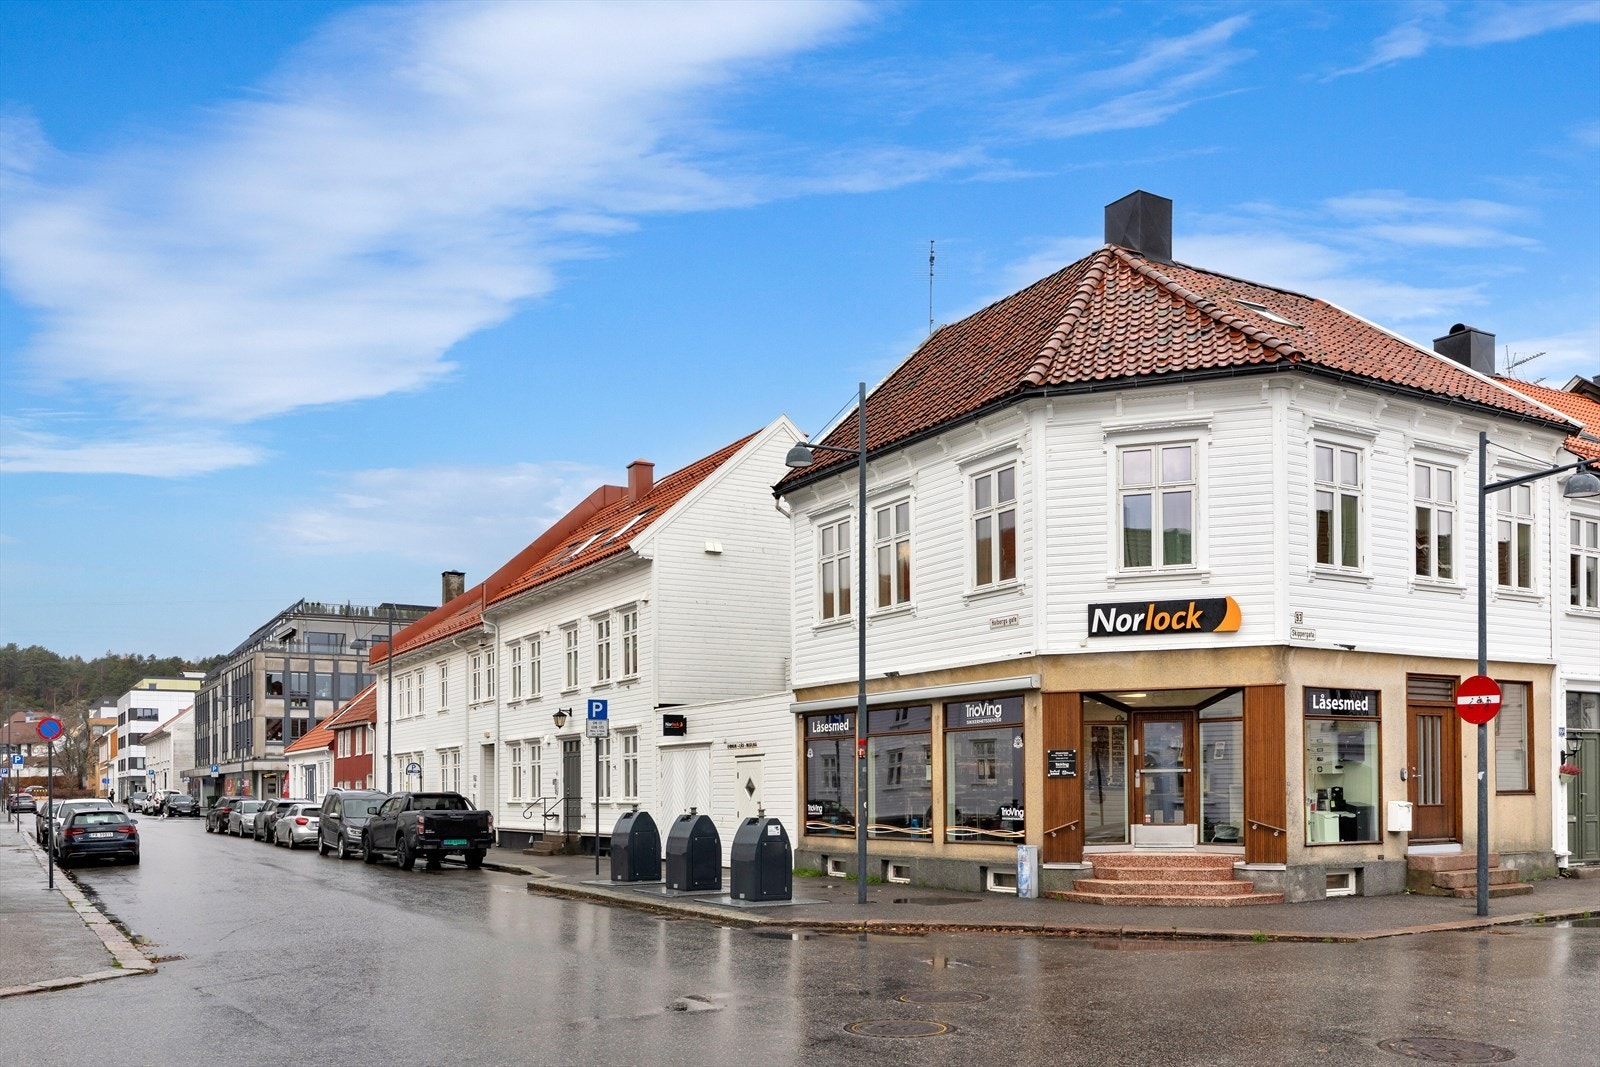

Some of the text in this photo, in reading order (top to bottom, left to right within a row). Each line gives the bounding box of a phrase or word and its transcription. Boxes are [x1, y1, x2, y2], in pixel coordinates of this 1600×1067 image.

[1091, 602, 1204, 632] Norlock
[592, 701, 603, 718] P
[965, 702, 1002, 718] TrioVing
[1312, 693, 1369, 711] Låsesmed
[812, 718, 849, 733] Låsesmed
